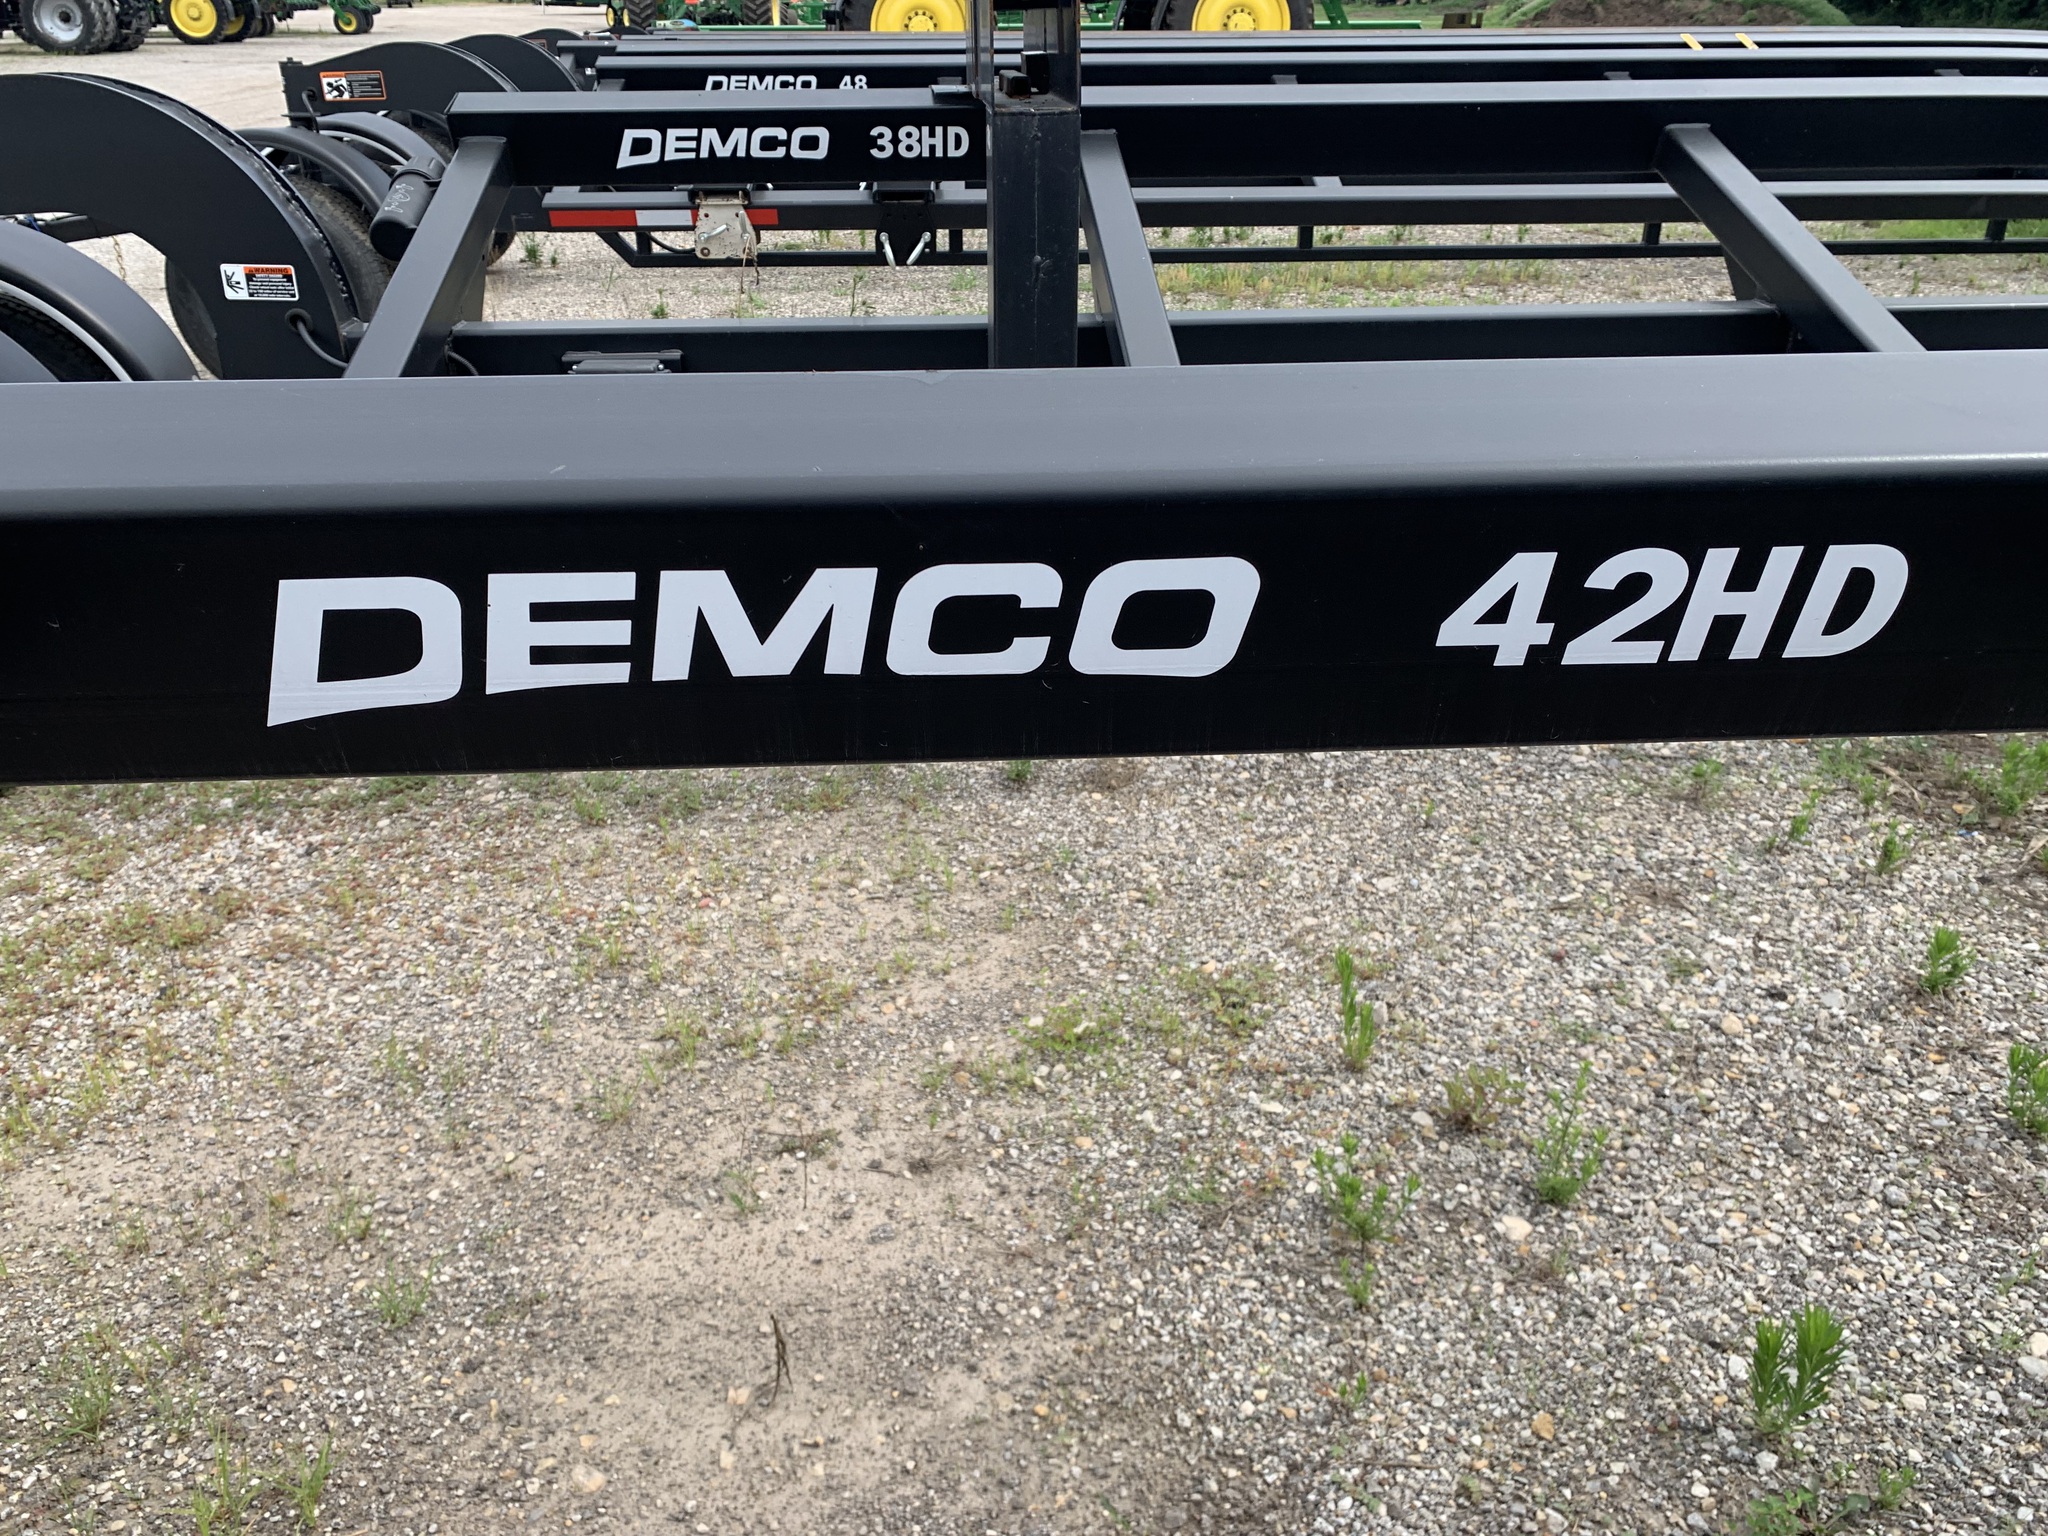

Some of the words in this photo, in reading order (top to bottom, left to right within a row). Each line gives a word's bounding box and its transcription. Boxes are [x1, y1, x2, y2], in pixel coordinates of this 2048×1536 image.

[705, 75, 818, 90] DEMCO
[839, 74, 868, 89] 48
[616, 126, 830, 169] DEMCO
[869, 126, 969, 158] 38HD
[267, 556, 1260, 727] DEMCO
[1436, 543, 1909, 667] 42HD
